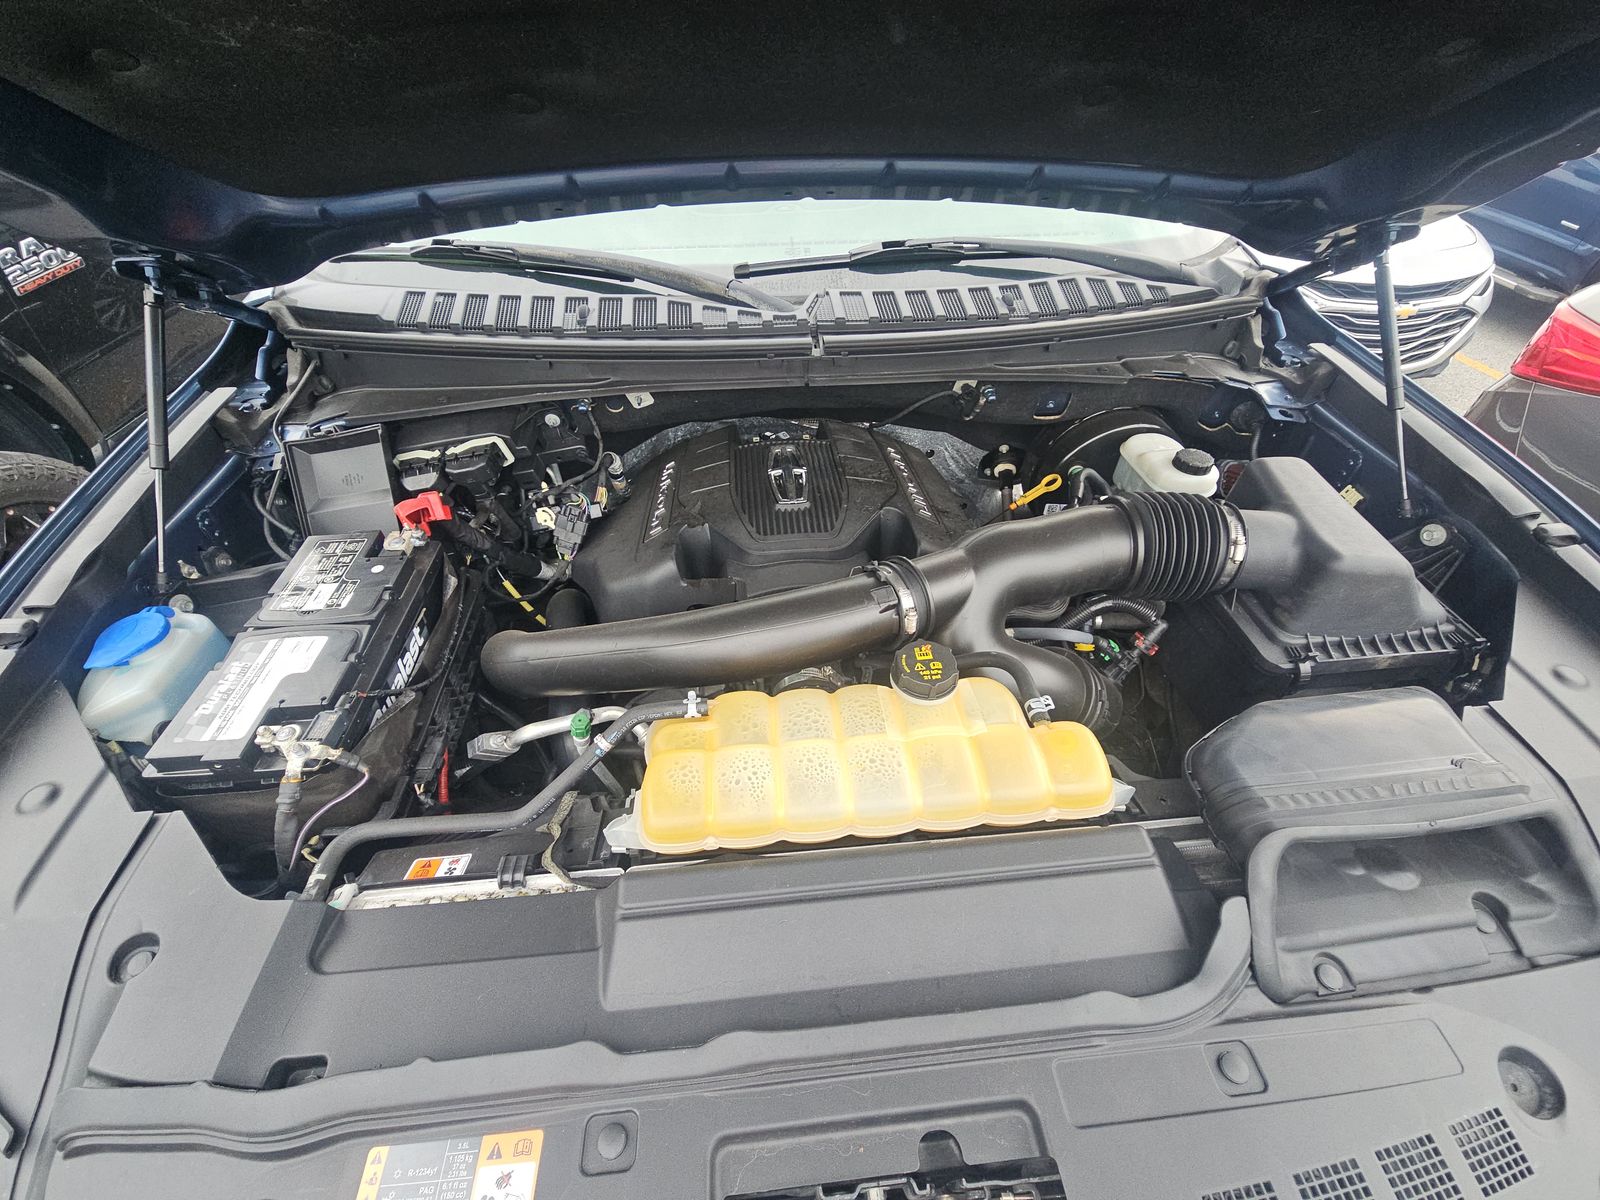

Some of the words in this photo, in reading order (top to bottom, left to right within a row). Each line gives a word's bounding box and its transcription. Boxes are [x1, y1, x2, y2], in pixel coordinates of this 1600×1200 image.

[0, 236, 53, 270] RA
[18, 270, 54, 295] HEAVY
[55, 259, 82, 278] DUTY
[649, 461, 676, 535] LINCOLN
[194, 659, 246, 717] Duralast
[407, 1166, 438, 1177] R-1234yf
[465, 1154, 473, 1163] kg
[419, 1186, 435, 1194] PAG
